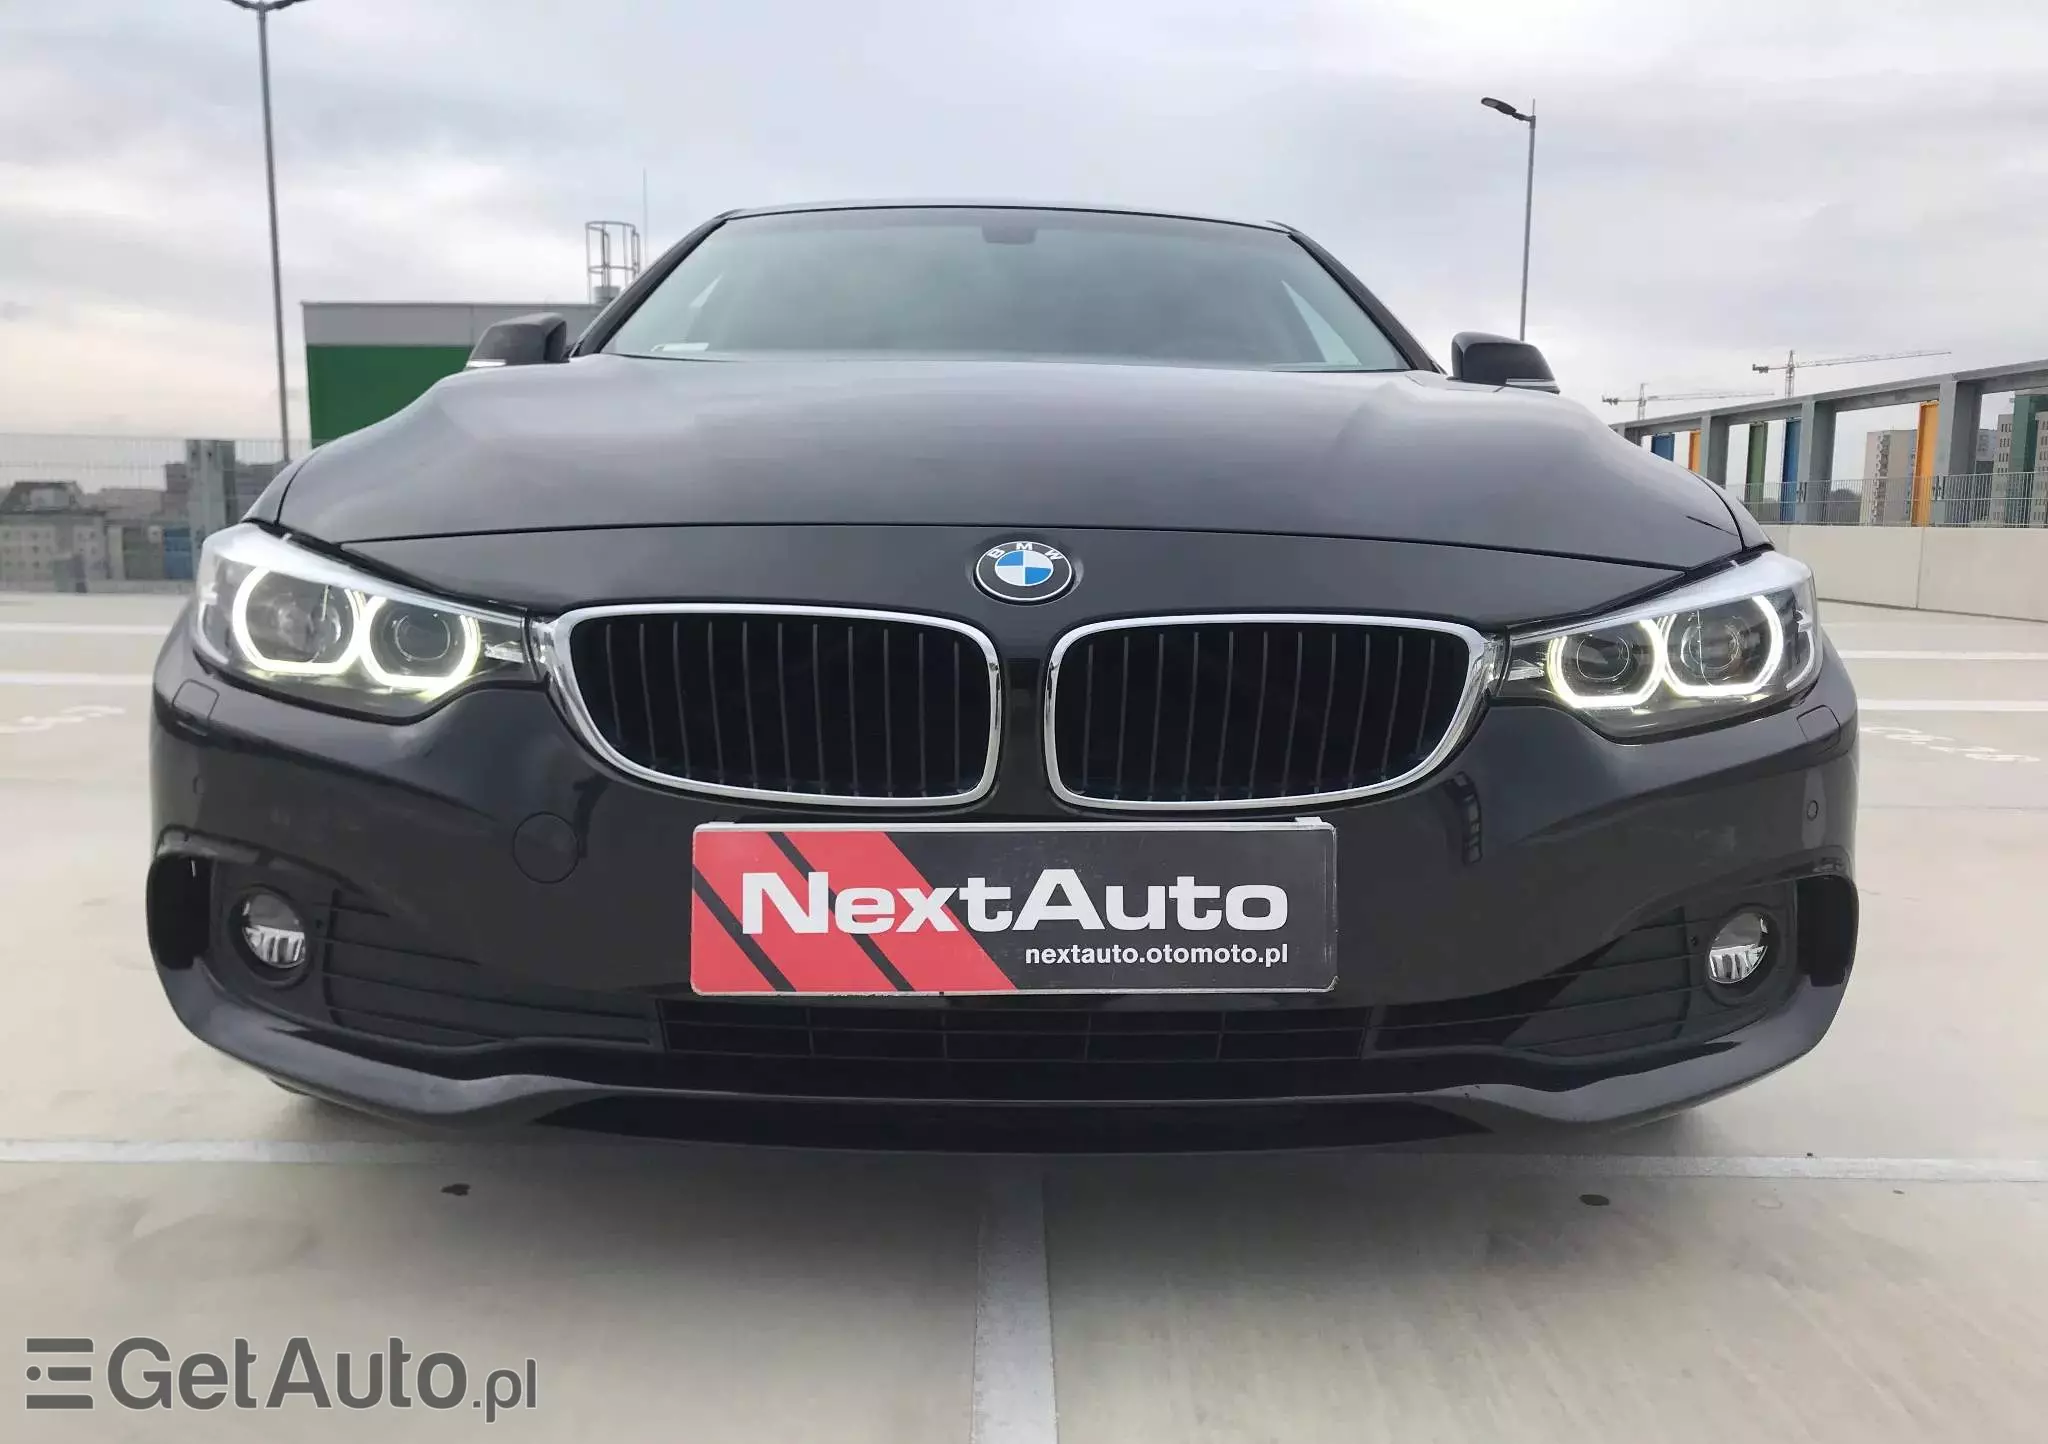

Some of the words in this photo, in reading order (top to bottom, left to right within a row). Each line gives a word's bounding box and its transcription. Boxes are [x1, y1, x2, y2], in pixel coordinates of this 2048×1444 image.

[987, 542, 1063, 560] BMW
[741, 868, 1288, 934] NextAuto
[1024, 943, 1289, 967] nextauto.otomoto.pl
